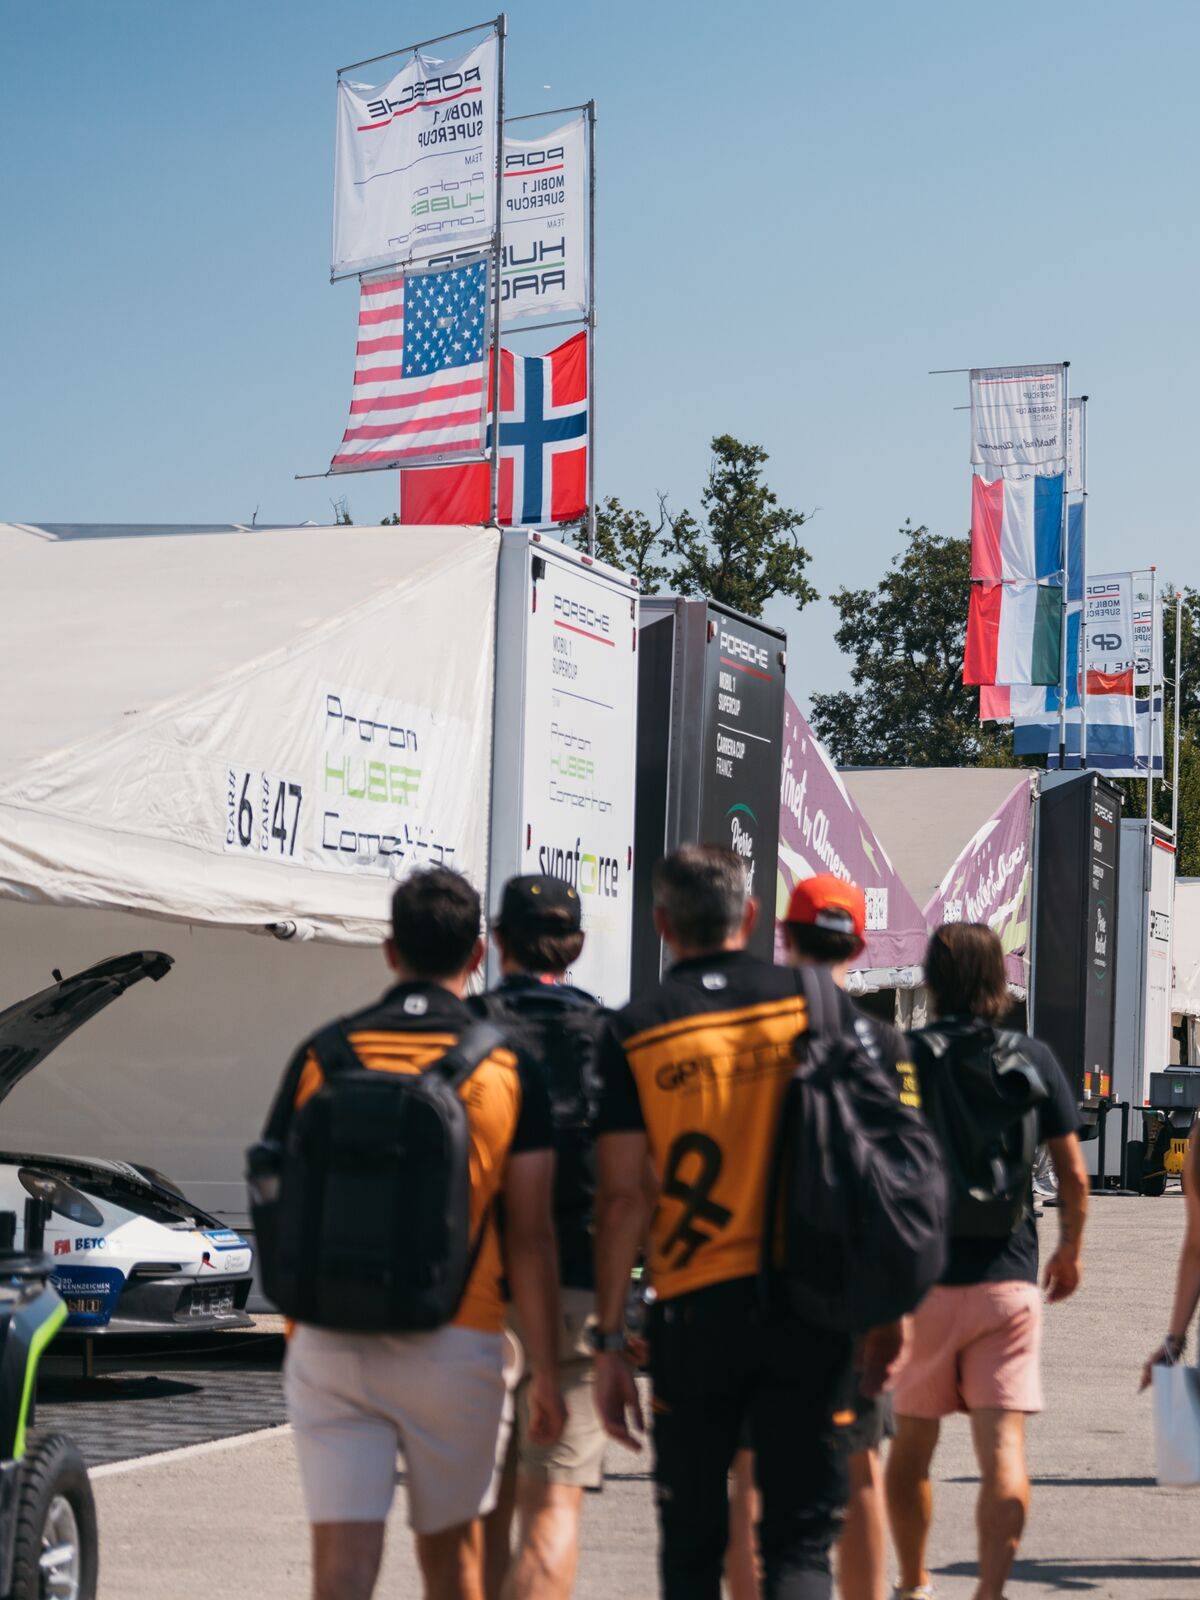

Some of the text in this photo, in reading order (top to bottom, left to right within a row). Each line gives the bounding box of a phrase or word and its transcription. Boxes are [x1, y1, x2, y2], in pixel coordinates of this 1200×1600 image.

[554, 595, 610, 633] PORSCHE
[552, 635, 568, 656] MOBIL
[720, 631, 769, 670] PORSCHE
[552, 656, 578, 680] SUPERCUP
[719, 670, 733, 692] MOBIL
[718, 689, 741, 717] SUPERCUP
[716, 732, 746, 760] CARRERA CUP
[716, 756, 733, 779] FRANCE
[237, 772, 253, 848] 6
[271, 780, 302, 856] 47
[802, 806, 812, 847] by
[75, 1237, 106, 1251] BETO
